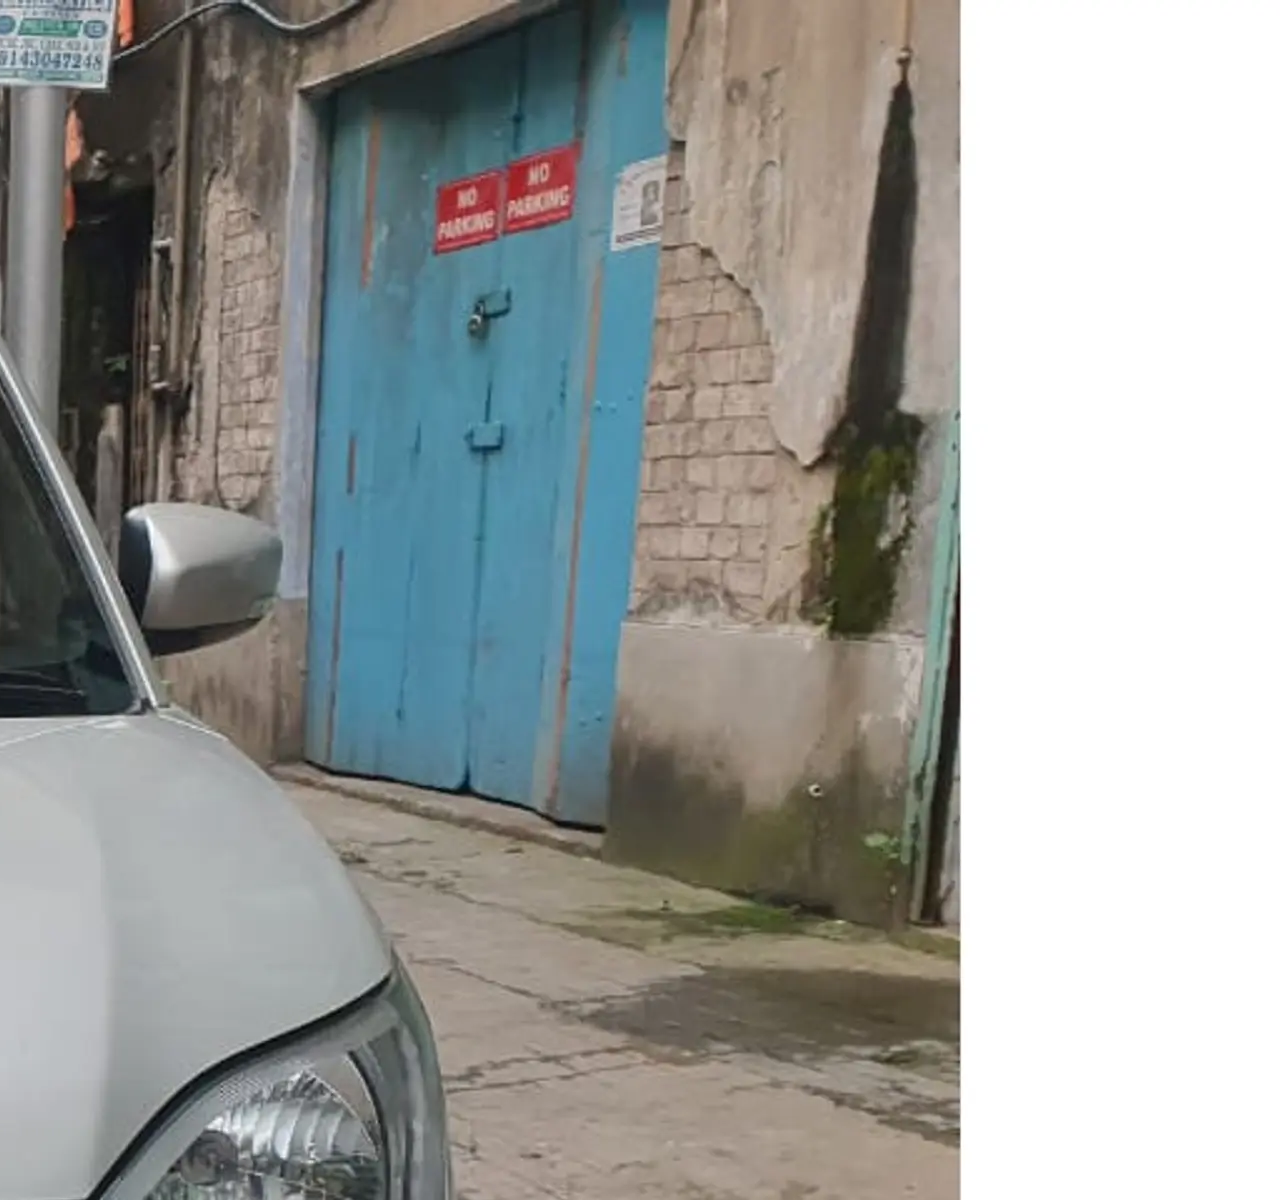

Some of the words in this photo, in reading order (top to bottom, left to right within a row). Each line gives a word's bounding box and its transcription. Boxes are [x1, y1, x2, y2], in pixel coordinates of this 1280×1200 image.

[528, 162, 550, 186] NO
[457, 185, 478, 209] NO
[506, 185, 570, 219] PARKING
[437, 210, 495, 240] PARKING
